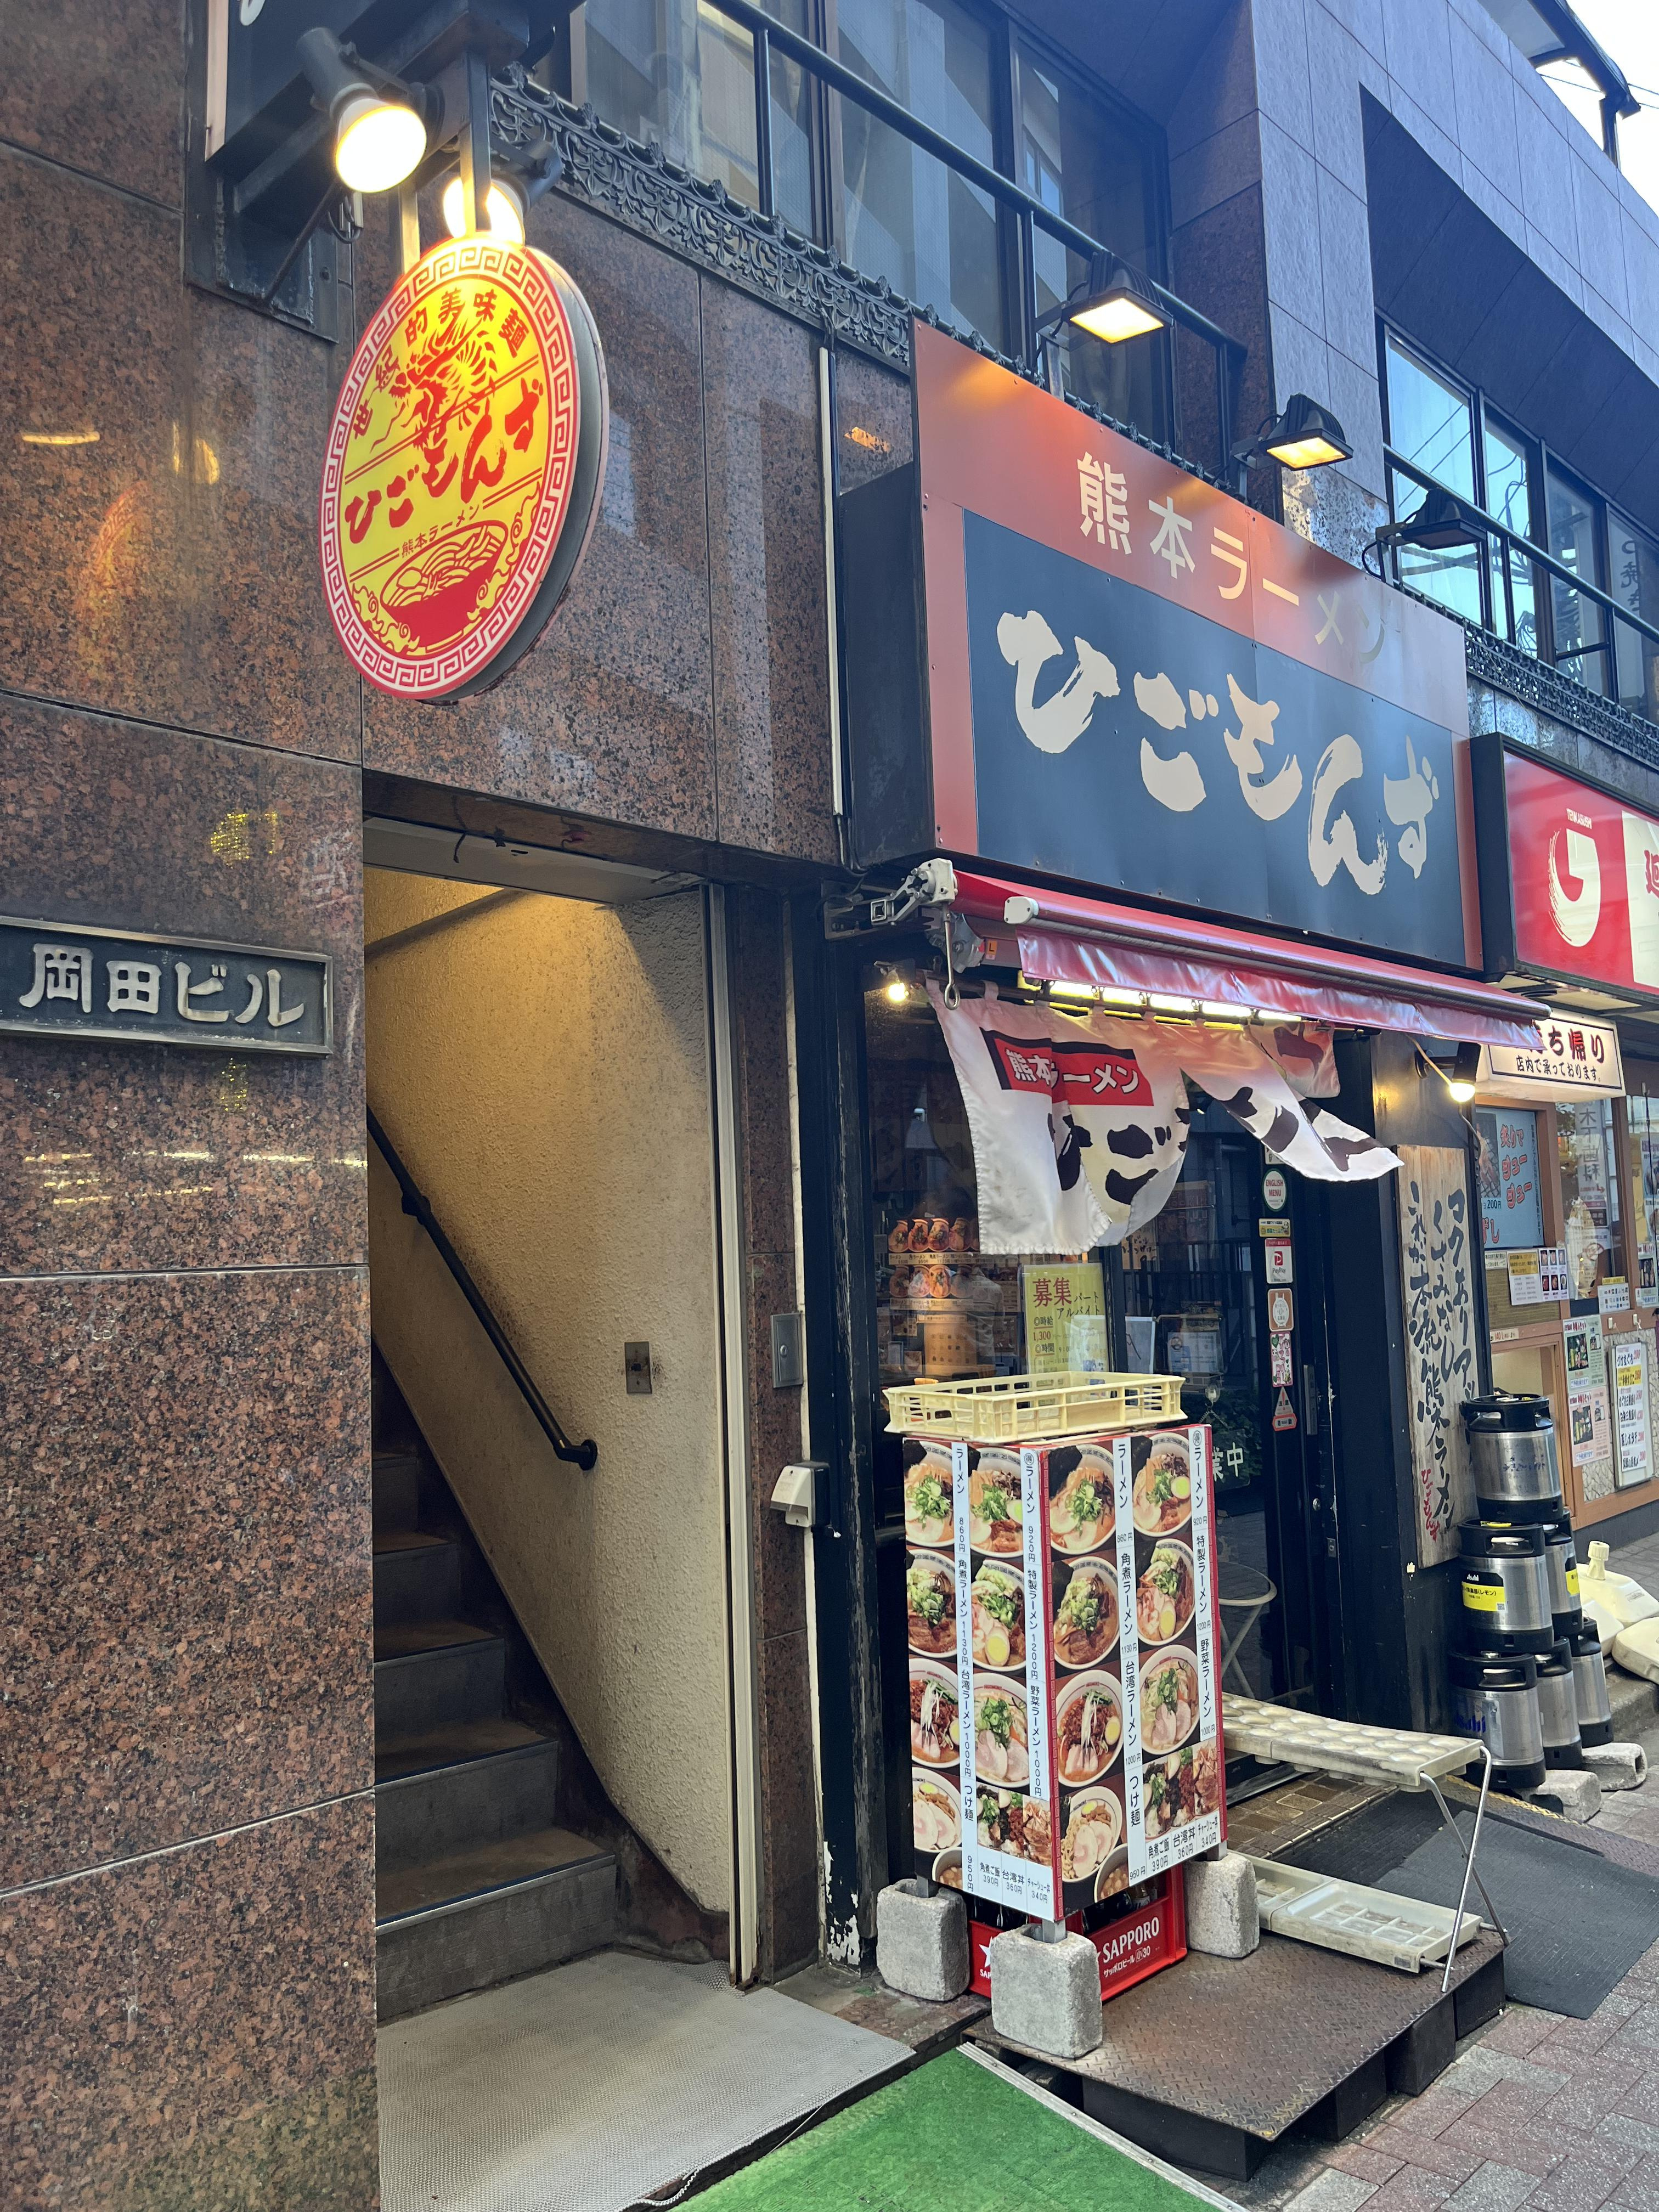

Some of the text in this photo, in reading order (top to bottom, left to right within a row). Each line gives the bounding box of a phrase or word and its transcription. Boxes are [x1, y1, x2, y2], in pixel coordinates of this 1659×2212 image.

[402, 504, 479, 558] 熊本ラーメン
[1077, 451, 1385, 664] 熊本ラーメン
[996, 610, 1438, 894] ひごもんず
[19, 943, 304, 1026] 岡田ビル
[1032, 1277, 1072, 1308] 募集
[956, 1448, 965, 1494] ラーメン
[1118, 1443, 1128, 1508] ラーメン
[1200, 1638, 1211, 1718] 野菜ラーメン
[961, 1669, 970, 1729] 台湾ラーメン
[1030, 1685, 1041, 1746] 野菜ラーメン
[1125, 1660, 1137, 1746] 台湾ラーメン
[964, 1785, 974, 1821] つけ麺
[1130, 1775, 1141, 1827] つけ麺
[1148, 1837, 1170, 1860] 角煮ご飯
[1173, 1826, 1195, 1848] 台湾丼
[1177, 1843, 1194, 1860] 360円
[1201, 1832, 1217, 1848] 340円
[983, 1874, 999, 1887] 390円
[1002, 1869, 1025, 1884] 台湾丼
[1129, 1865, 1146, 1881] 950円
[1152, 1854, 1169, 1872] 390円
[1006, 1882, 1023, 1895] 360円
[1031, 1890, 1048, 1904] 340円
[1103, 1916, 1160, 1963] SAPPORO
[1103, 1955, 1135, 1978] サッポロビール
